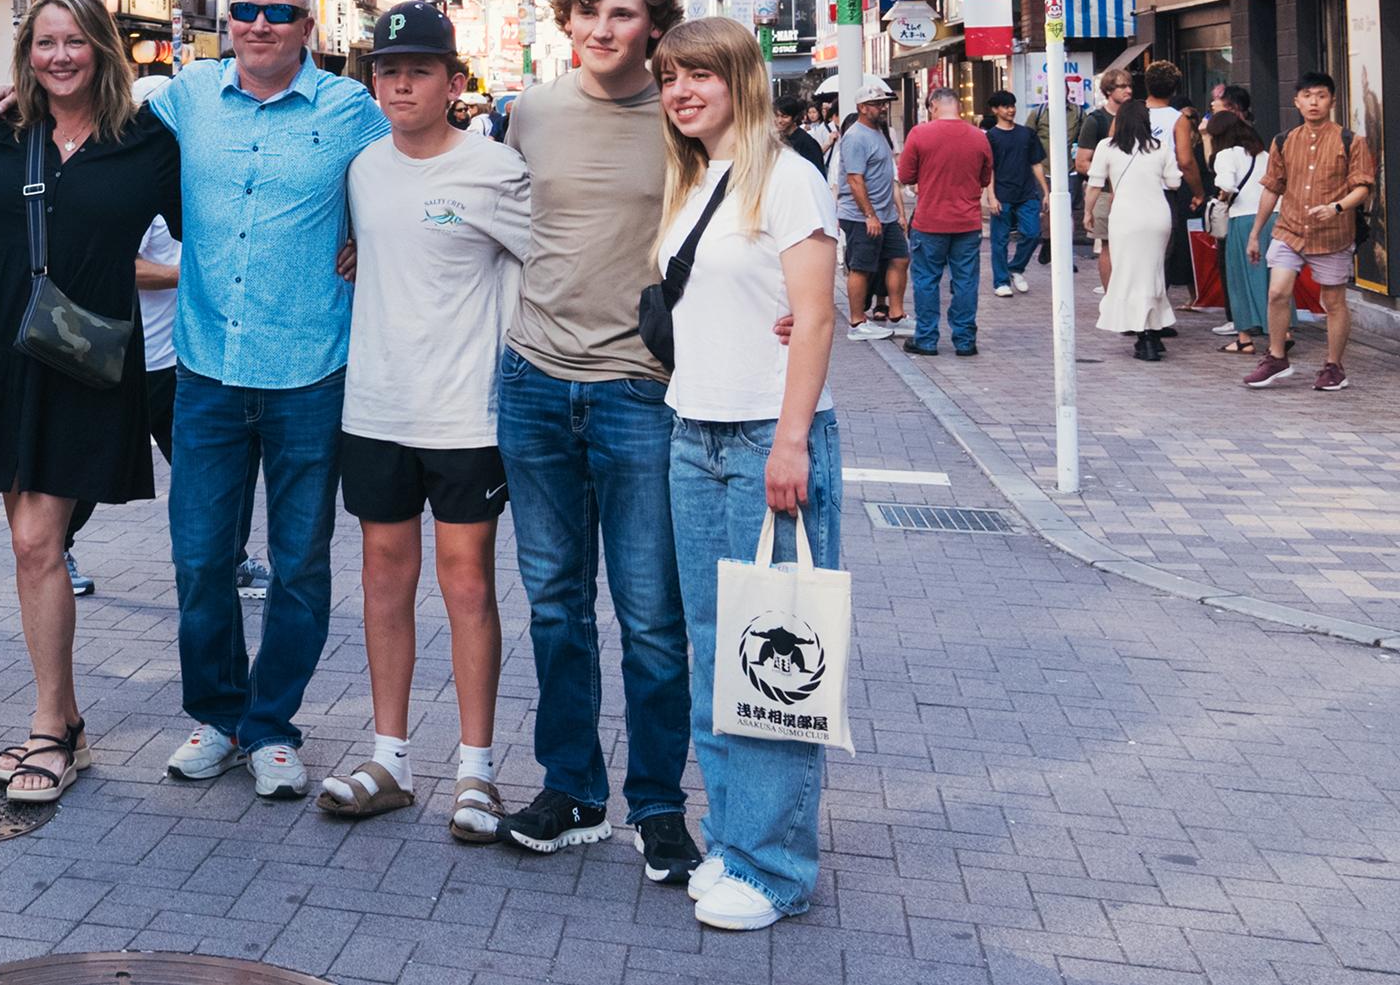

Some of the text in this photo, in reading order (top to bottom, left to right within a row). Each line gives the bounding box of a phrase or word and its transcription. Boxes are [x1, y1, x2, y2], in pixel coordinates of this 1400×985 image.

[388, 13, 407, 40] P
[1042, 61, 1078, 74] CIN
[424, 198, 466, 211] SALTY CREW
[736, 702, 829, 732] 浅草相撲部屋
[736, 718, 830, 741] ASAKUSA SUMO CLUB
